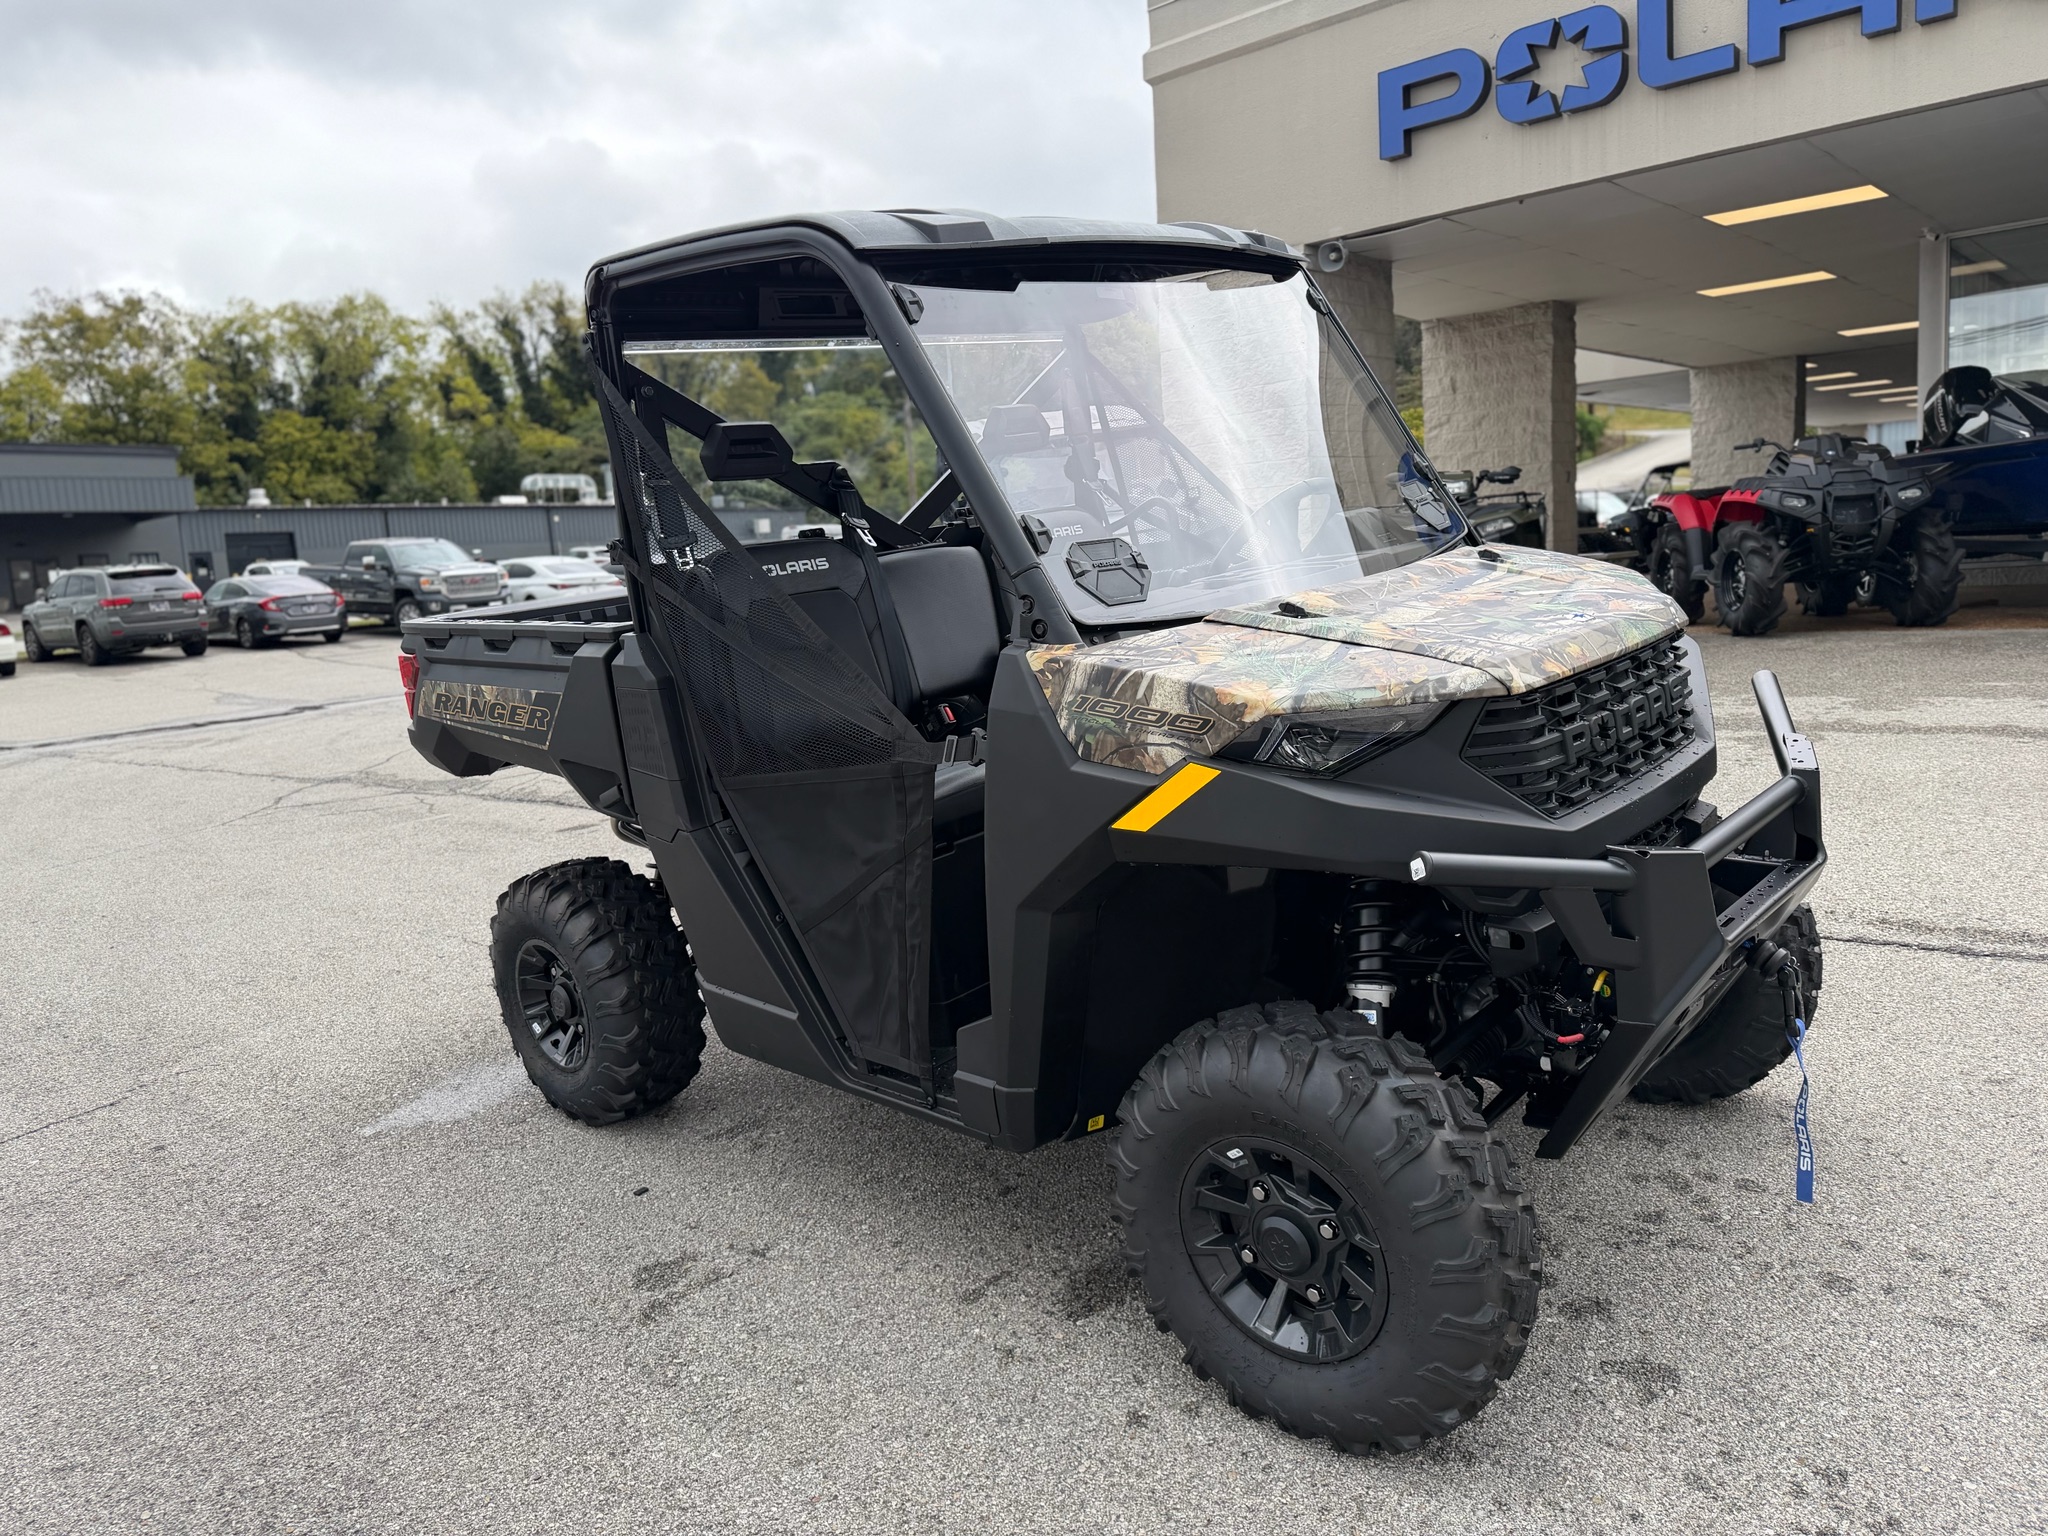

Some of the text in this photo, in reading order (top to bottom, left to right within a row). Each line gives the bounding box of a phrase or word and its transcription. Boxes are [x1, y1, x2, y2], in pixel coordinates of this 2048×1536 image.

[761, 557, 830, 577] OLARIS
[433, 692, 551, 731] RANGER
[1072, 694, 1215, 736] 1000
[1562, 665, 1692, 766] POLARIS
[1796, 1084, 1811, 1171] POLARIS
